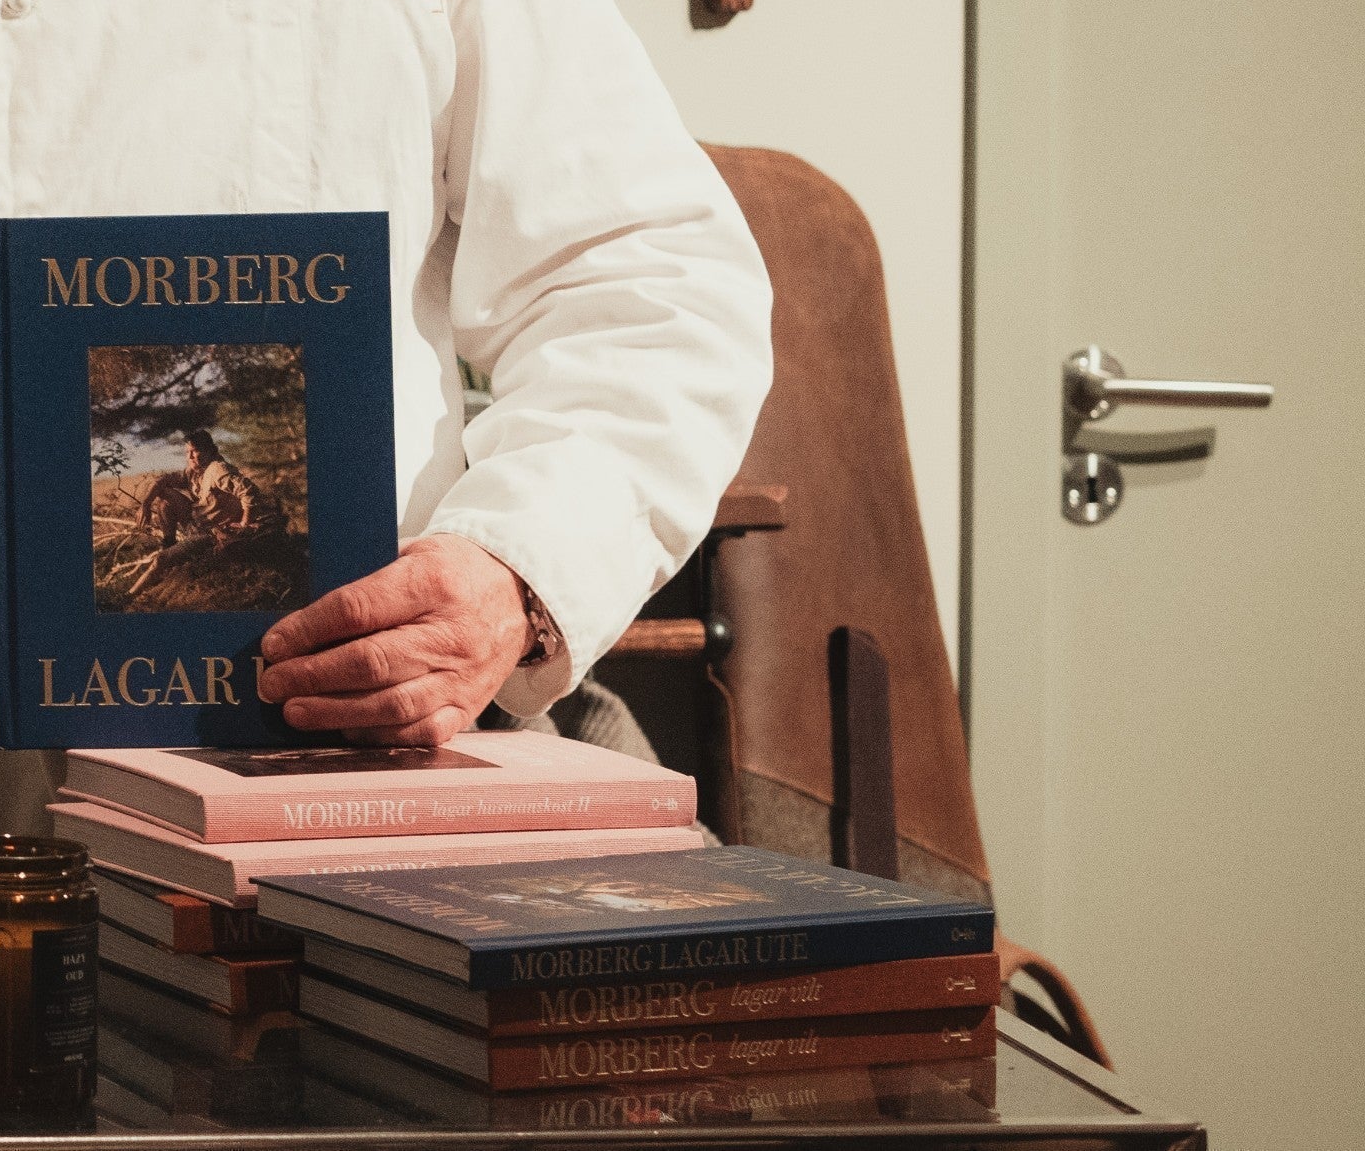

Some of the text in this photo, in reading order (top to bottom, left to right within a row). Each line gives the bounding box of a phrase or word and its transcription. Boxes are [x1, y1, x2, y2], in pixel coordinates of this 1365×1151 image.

[41, 253, 351, 307] MORBERG
[38, 656, 240, 707] LAGAR
[282, 799, 419, 830] MORBERG
[431, 800, 472, 821] lagar
[477, 797, 574, 815] husmanskost
[510, 931, 810, 981] MORBERG LAGAR UTE
[537, 976, 824, 1027] MORBERG lagar vilt
[537, 1026, 819, 1080] MORBERG lagar vilt
